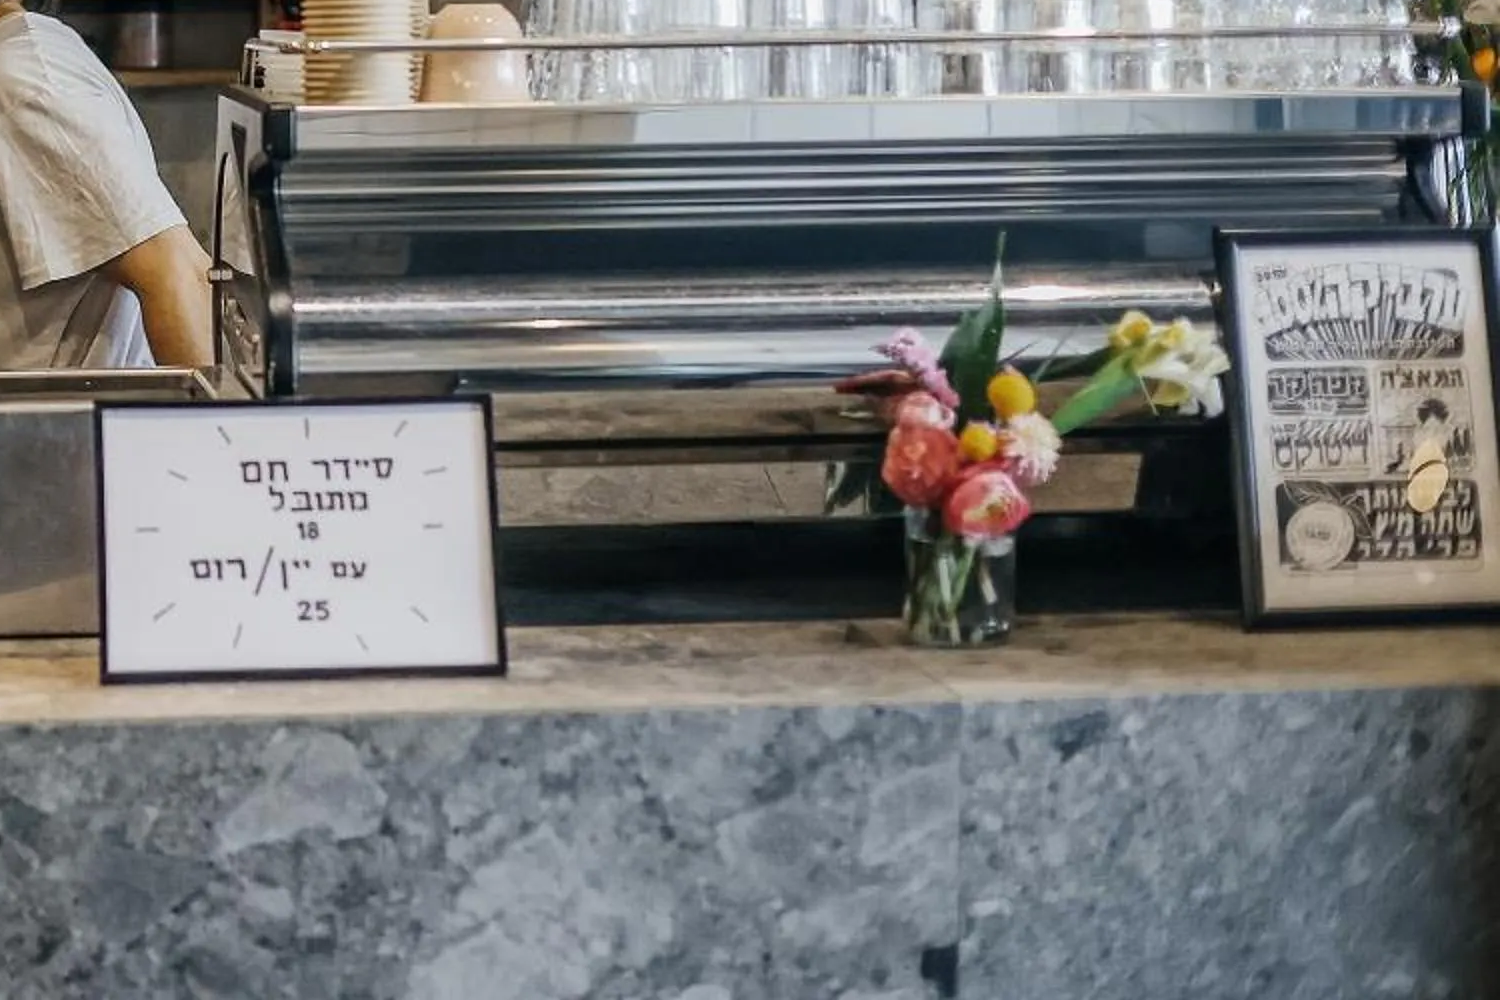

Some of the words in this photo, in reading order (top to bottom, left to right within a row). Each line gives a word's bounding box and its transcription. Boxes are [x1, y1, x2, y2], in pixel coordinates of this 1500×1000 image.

[240, 459, 289, 484] חם
[269, 486, 369, 512] מתובל
[297, 521, 320, 540] 18
[331, 558, 367, 580] עם
[297, 601, 331, 622] 25
